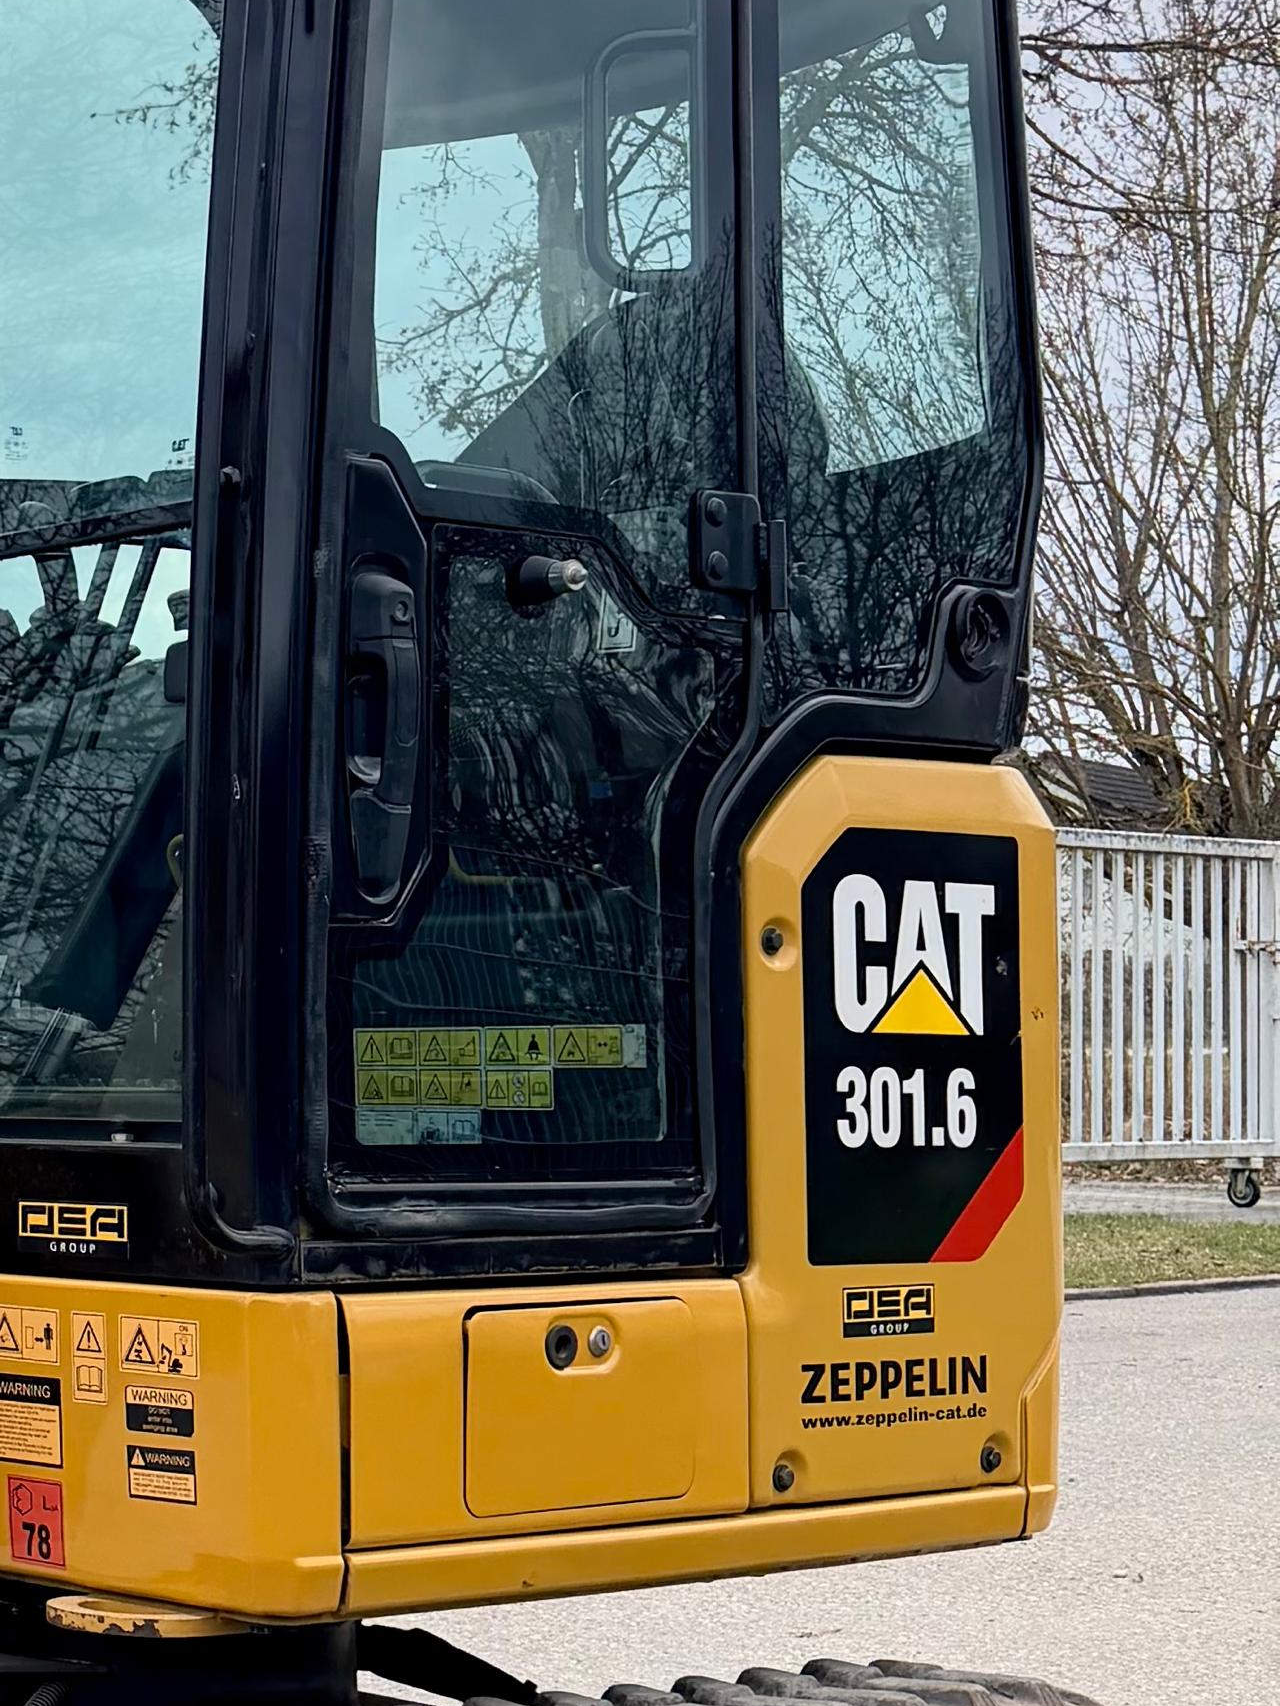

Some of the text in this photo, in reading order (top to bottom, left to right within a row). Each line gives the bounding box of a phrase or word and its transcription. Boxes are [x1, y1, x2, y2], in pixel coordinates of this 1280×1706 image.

[833, 874, 995, 1035] CAT
[836, 1066, 977, 1148] 301.6
[49, 1241, 96, 1253] GROUP
[870, 1323, 909, 1335] GROUP
[801, 1355, 987, 1404] ZEPPELIN
[131, 1389, 188, 1406] WARNING
[802, 1403, 987, 1429] www.zeppelin-cat.de
[145, 1453, 190, 1467] WARNING
[22, 1521, 51, 1560] 78
